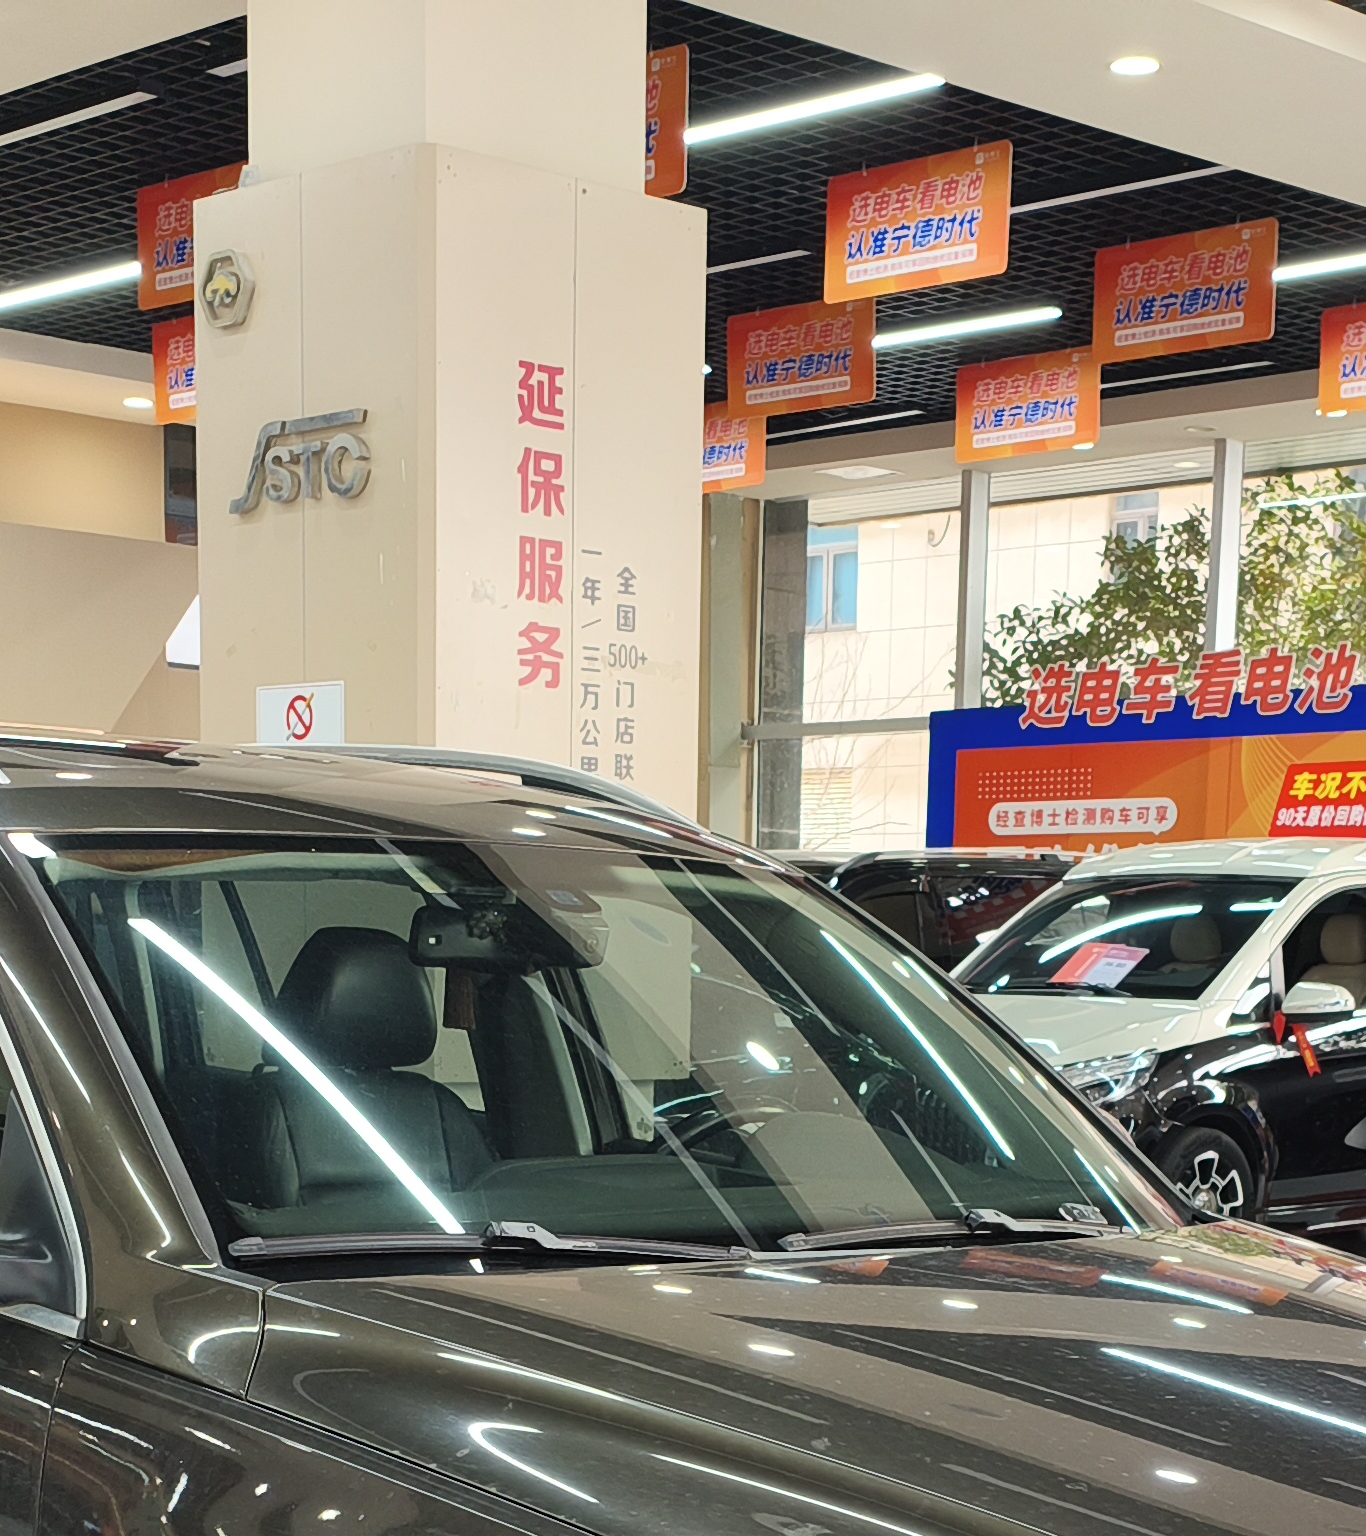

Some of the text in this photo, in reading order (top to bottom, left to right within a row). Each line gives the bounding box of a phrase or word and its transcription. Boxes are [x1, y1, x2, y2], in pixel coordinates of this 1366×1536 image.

[846, 208, 982, 260] 认准宁德时代
[1113, 279, 1249, 327] 认准宁德时代
[744, 347, 852, 387] 认准宁德时代
[972, 394, 1078, 432] 认准宁德时代
[517, 360, 566, 690] 延保服务
[1018, 643, 1362, 730] 选电车看电池
[995, 804, 1170, 828] 经查博士检测购车可享
